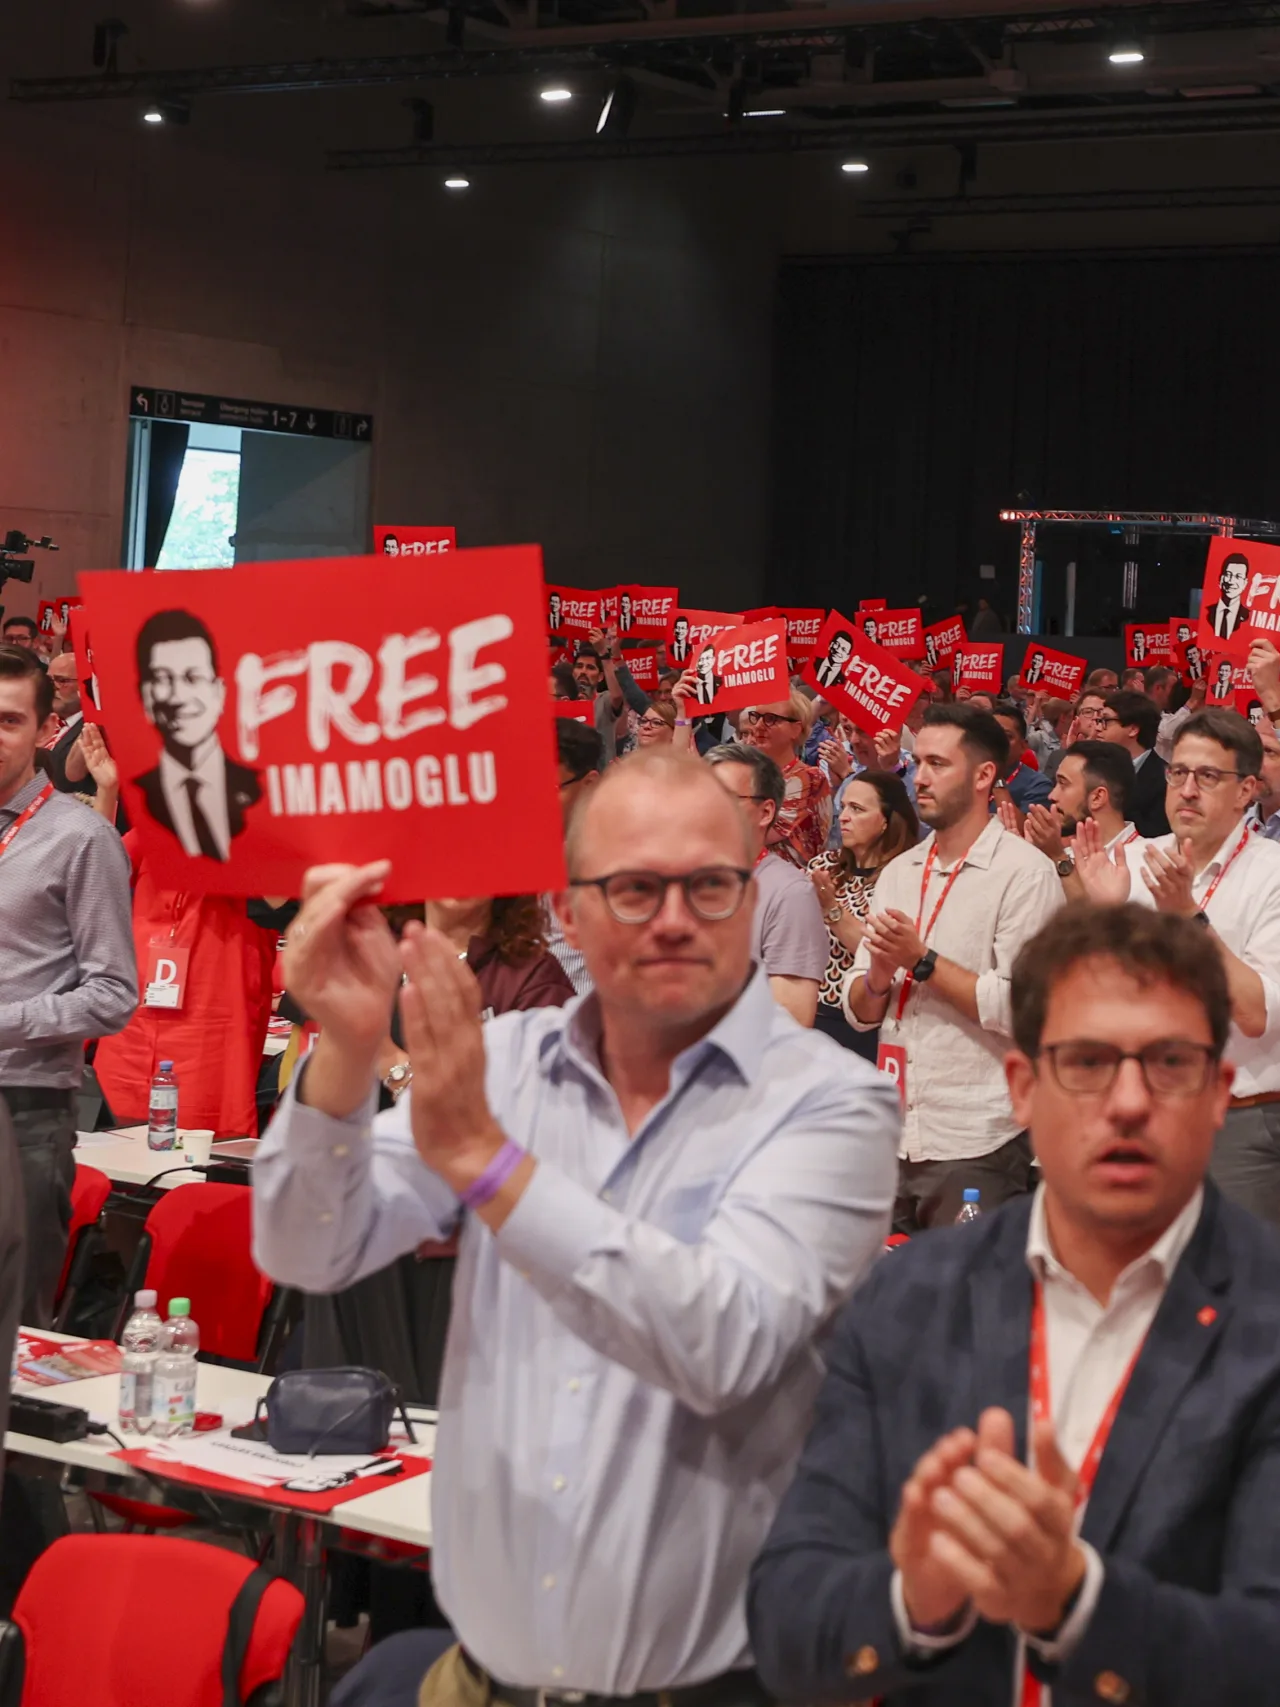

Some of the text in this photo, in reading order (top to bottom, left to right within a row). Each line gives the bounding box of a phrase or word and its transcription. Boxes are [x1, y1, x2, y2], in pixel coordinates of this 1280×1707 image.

[561, 600, 598, 618] FREE
[632, 597, 673, 616] FREE
[636, 617, 668, 627] IMAMOGLU
[788, 618, 821, 636] FREE
[878, 618, 917, 639] FREE
[882, 637, 915, 647] IMAMOGLU
[934, 624, 962, 650] FREE
[1146, 633, 1170, 648] FRE
[717, 634, 780, 675] FREE
[961, 653, 999, 672] FREE
[724, 667, 776, 688] IMAMOGLU
[963, 670, 993, 680] IMAMOGLU
[1042, 660, 1081, 680] FREE
[236, 614, 514, 761] FREE
[844, 655, 912, 708] FREE
[844, 680, 891, 724] IMAMOGLU
[266, 750, 497, 817] IMAMOGLU
[155, 958, 177, 985] D
